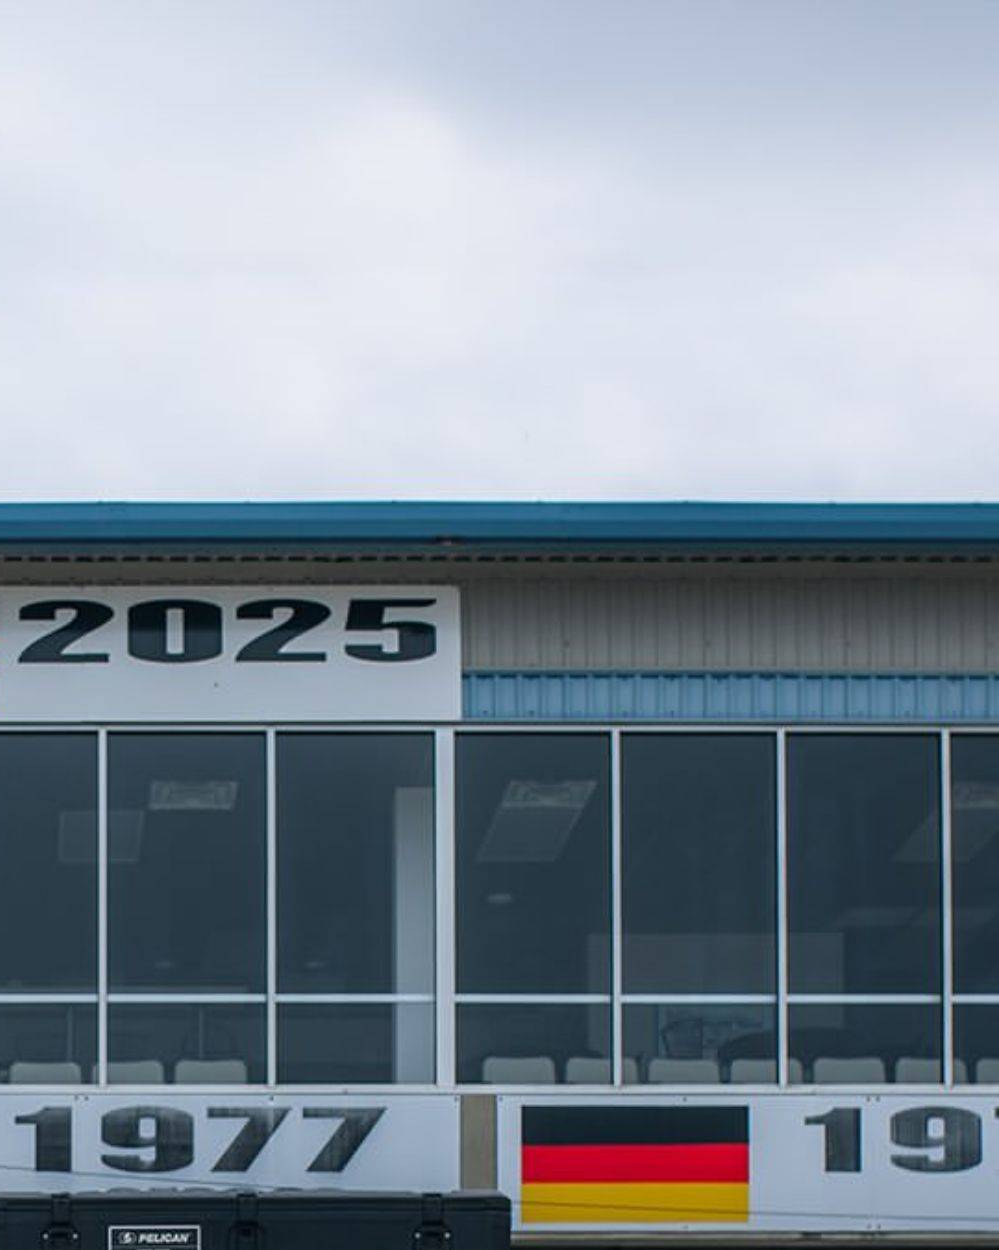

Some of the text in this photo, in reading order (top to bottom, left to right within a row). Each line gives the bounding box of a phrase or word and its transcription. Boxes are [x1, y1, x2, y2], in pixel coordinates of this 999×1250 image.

[18, 598, 438, 664] 2025
[15, 1106, 388, 1174] 1977
[805, 1106, 999, 1173] 19
[138, 1232, 190, 1244] PELICAN
